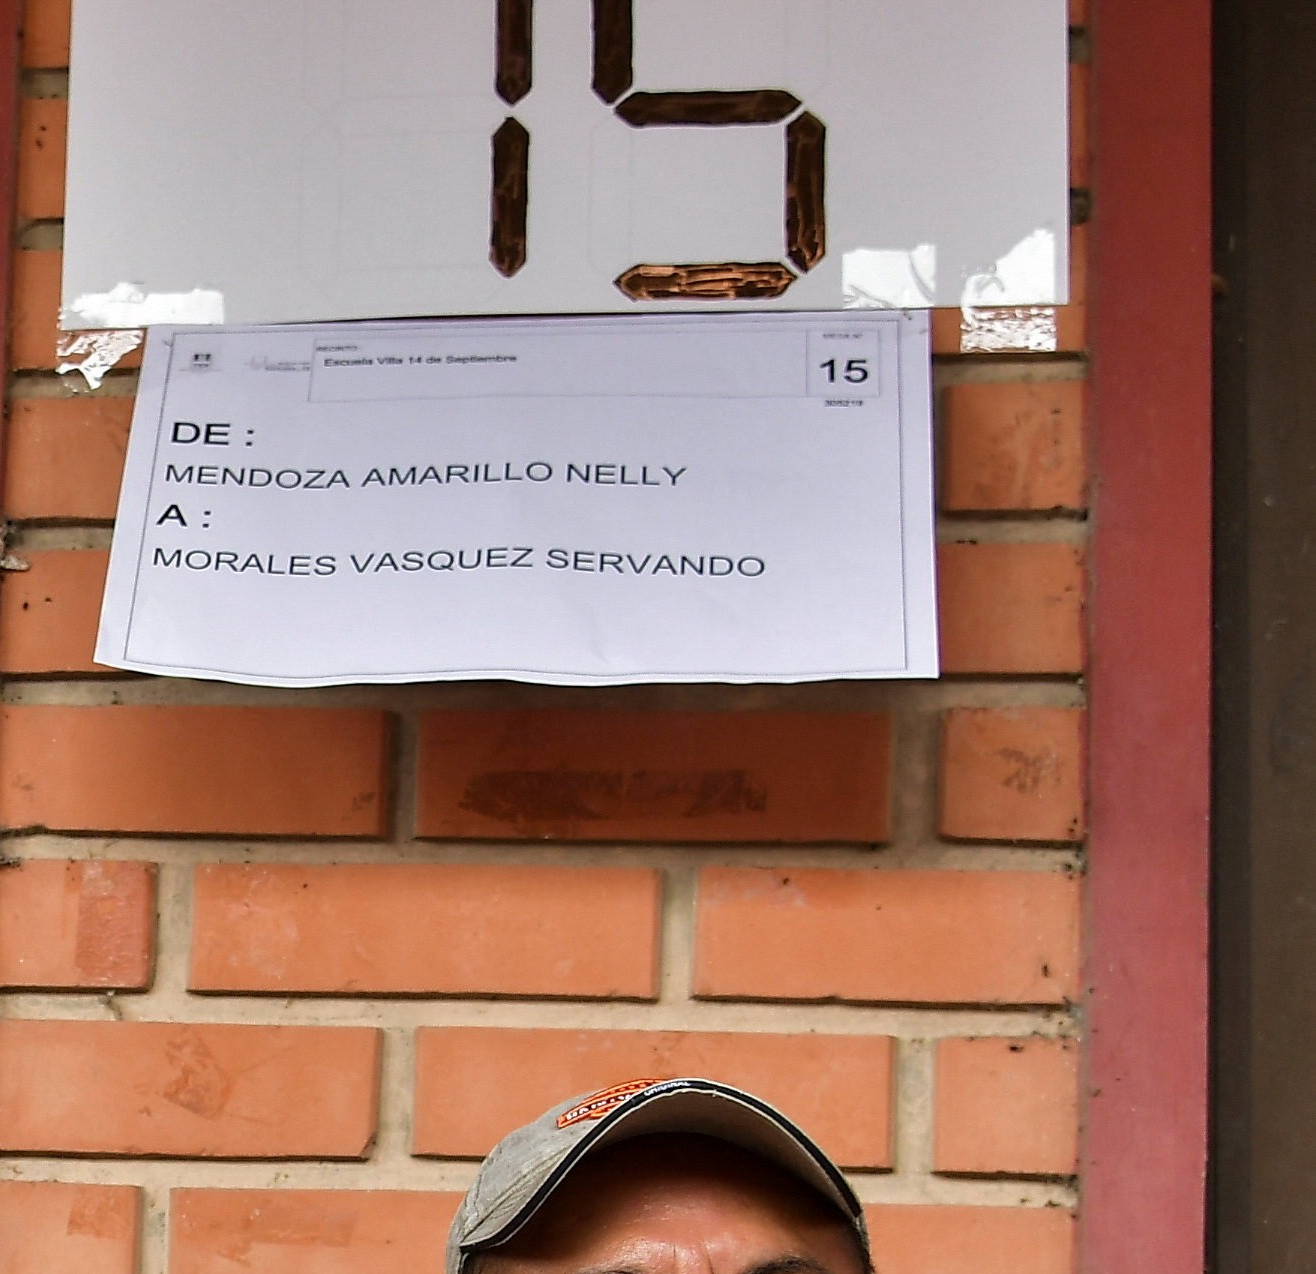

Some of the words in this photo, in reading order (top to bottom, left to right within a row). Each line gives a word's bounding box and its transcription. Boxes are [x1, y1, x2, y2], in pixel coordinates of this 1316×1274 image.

[324, 358, 373, 367] Escuela
[376, 357, 403, 366] Villa
[408, 356, 422, 365] 14
[426, 356, 442, 365] de
[446, 354, 518, 366] Septiembre
[819, 358, 868, 383] 15
[165, 463, 351, 490] MENDOZA
[360, 460, 553, 488] AMARILLO
[565, 462, 687, 488] NELLY
[152, 546, 337, 577] MORALES
[350, 546, 536, 576] VASQUEZ
[545, 547, 766, 577] SERVANDO
